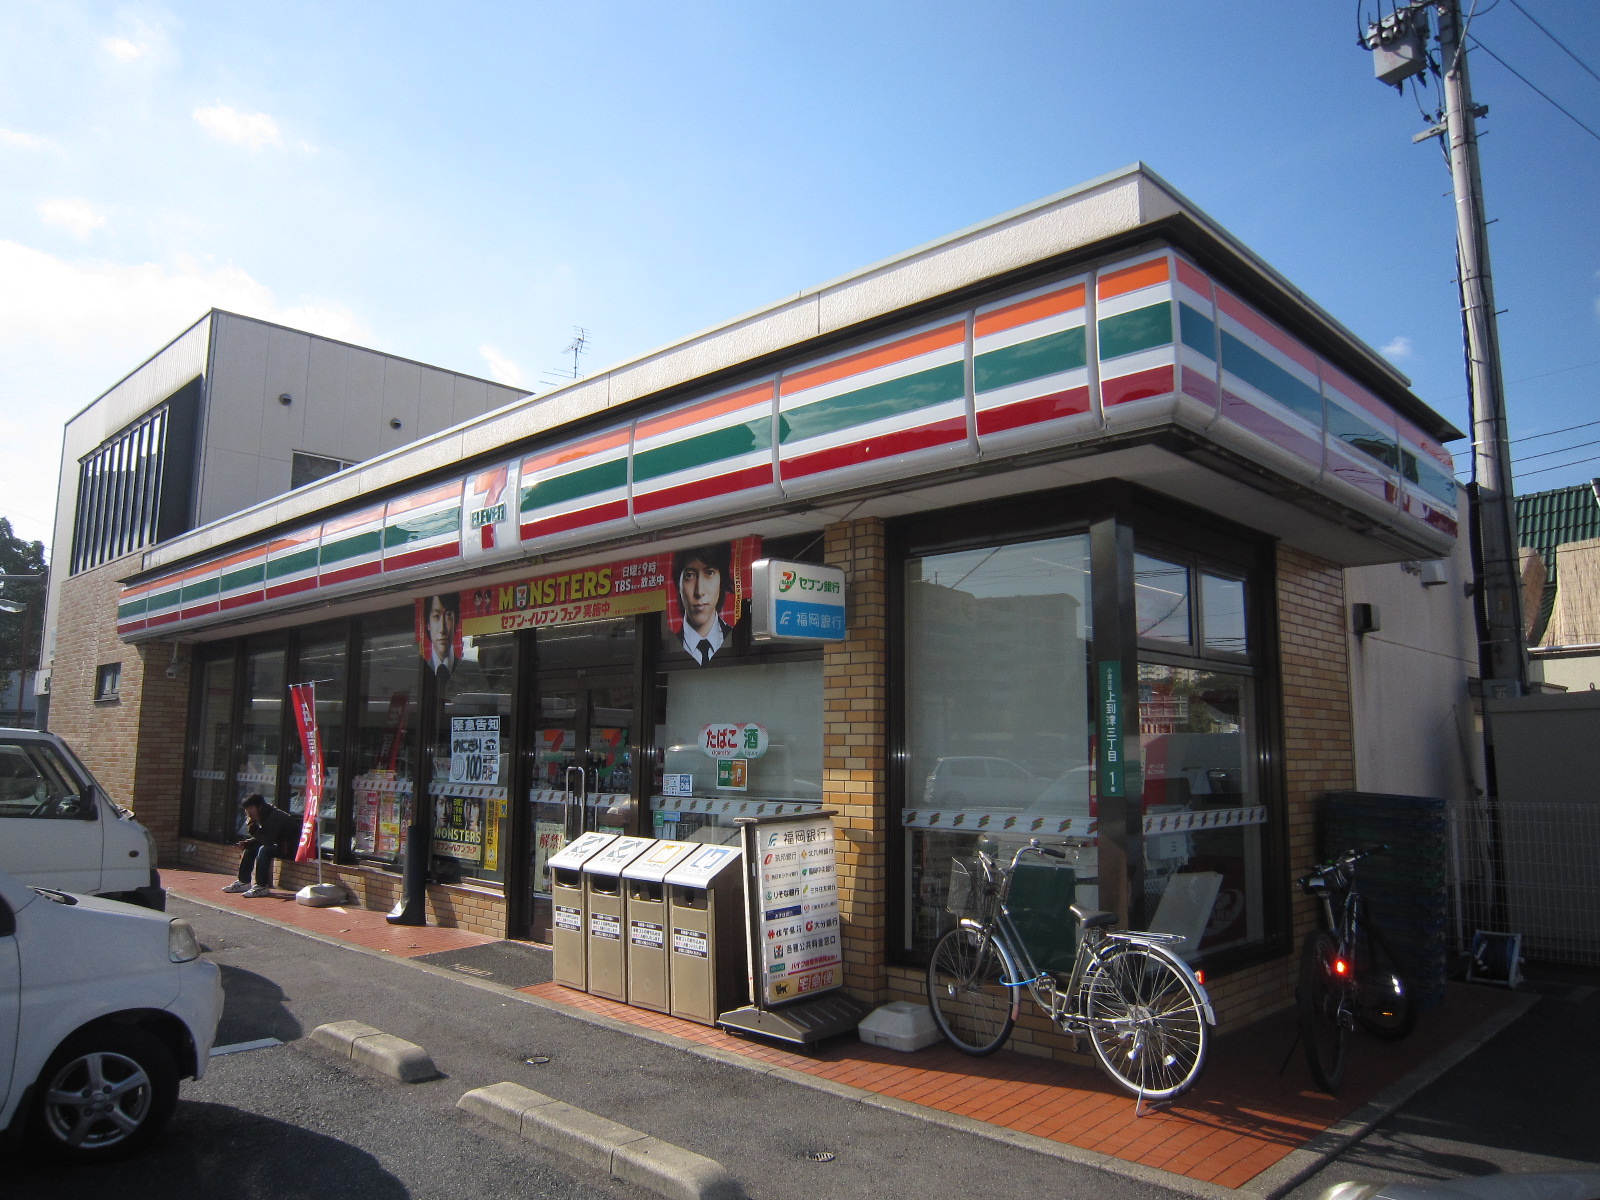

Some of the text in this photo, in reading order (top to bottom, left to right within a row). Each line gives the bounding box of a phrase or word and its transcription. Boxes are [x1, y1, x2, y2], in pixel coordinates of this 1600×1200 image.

[799, 577, 840, 594] セブン銀行
[583, 601, 611, 619] 実施中
[796, 612, 844, 630] 福岡銀行
[453, 719, 499, 731] 緊急告知
[1106, 691, 1117, 762] 上到津三丁目
[453, 738, 482, 753] おにぎり
[706, 728, 737, 749] たばこ
[744, 728, 758, 749] 酒
[434, 828, 482, 844] MONSTERS
[783, 827, 827, 845] 福岡銀行
[808, 847, 834, 857] 北九州銀行
[773, 888, 800, 899] りそな銀行
[810, 884, 836, 894] 三井住友銀行
[814, 917, 838, 929] 大分銀行
[786, 935, 836, 955] 各種公共料金窓口
[799, 970, 833, 992] 宅急便
